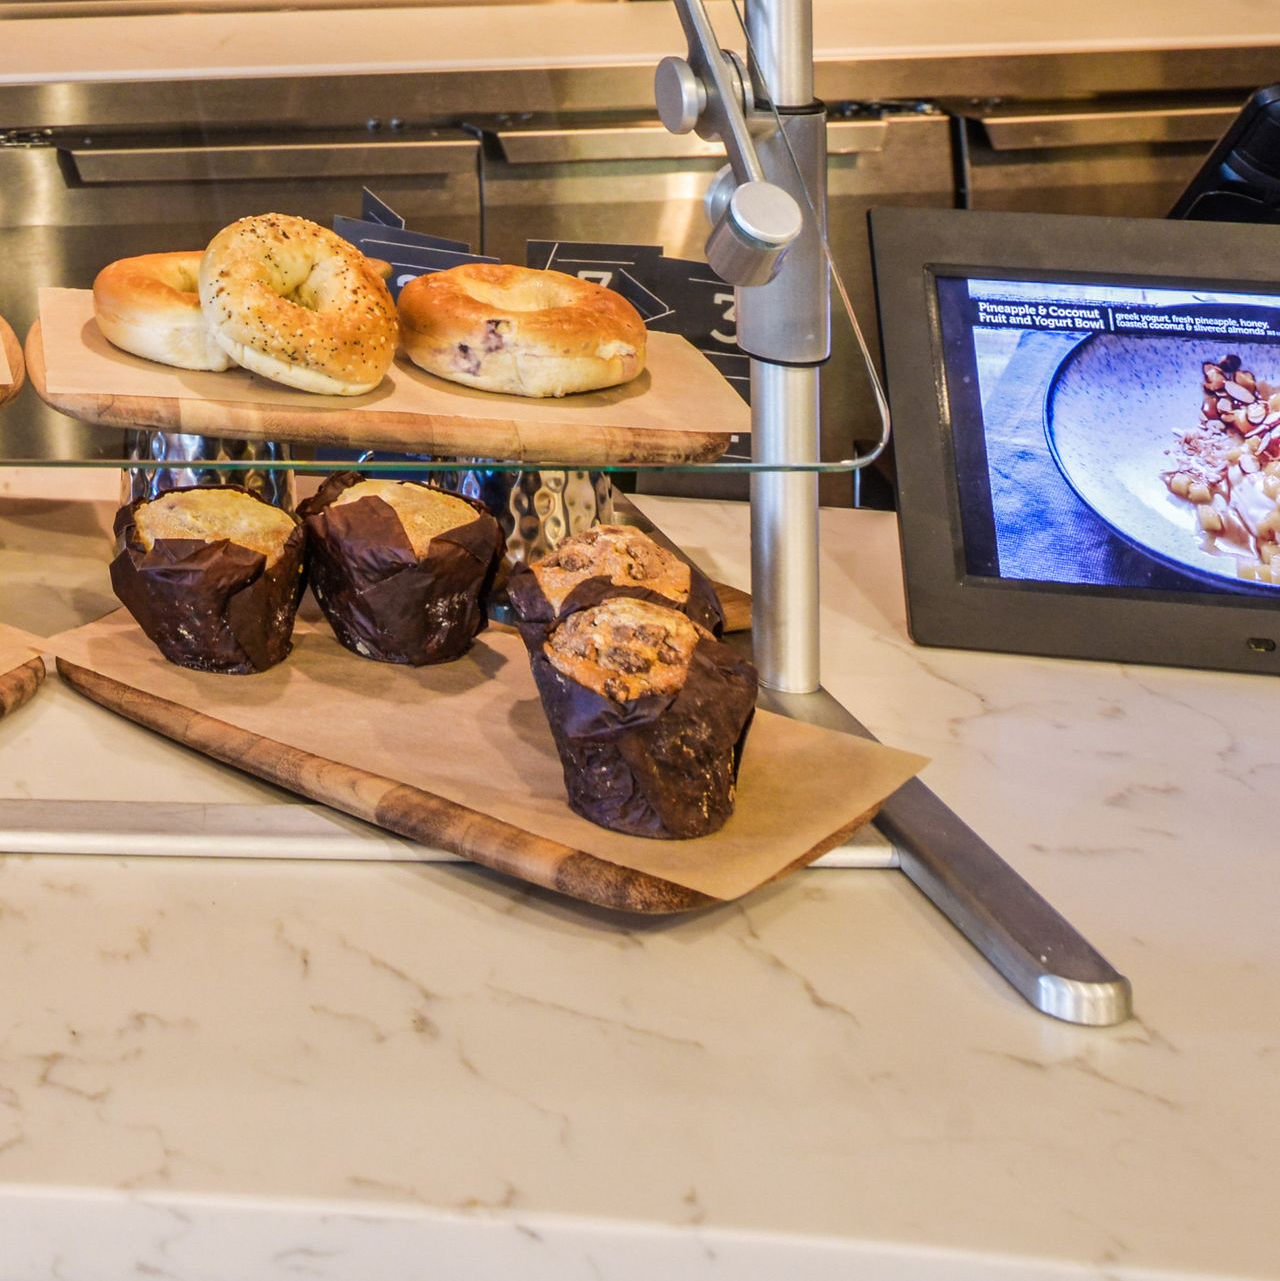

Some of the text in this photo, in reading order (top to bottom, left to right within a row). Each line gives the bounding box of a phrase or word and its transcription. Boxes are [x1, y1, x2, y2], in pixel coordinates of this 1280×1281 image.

[978, 302, 1036, 315] Pineapple
[1049, 307, 1099, 318] Coconut
[978, 313, 1105, 329] Fruit and Yogurt Bowl
[1116, 313, 1139, 322] greek
[1172, 315, 1193, 324] fresh
[1117, 320, 1147, 328] toasted
[1149, 322, 1185, 331] coconut
[1194, 324, 1226, 333] slivered
[1228, 326, 1265, 335] almonds
